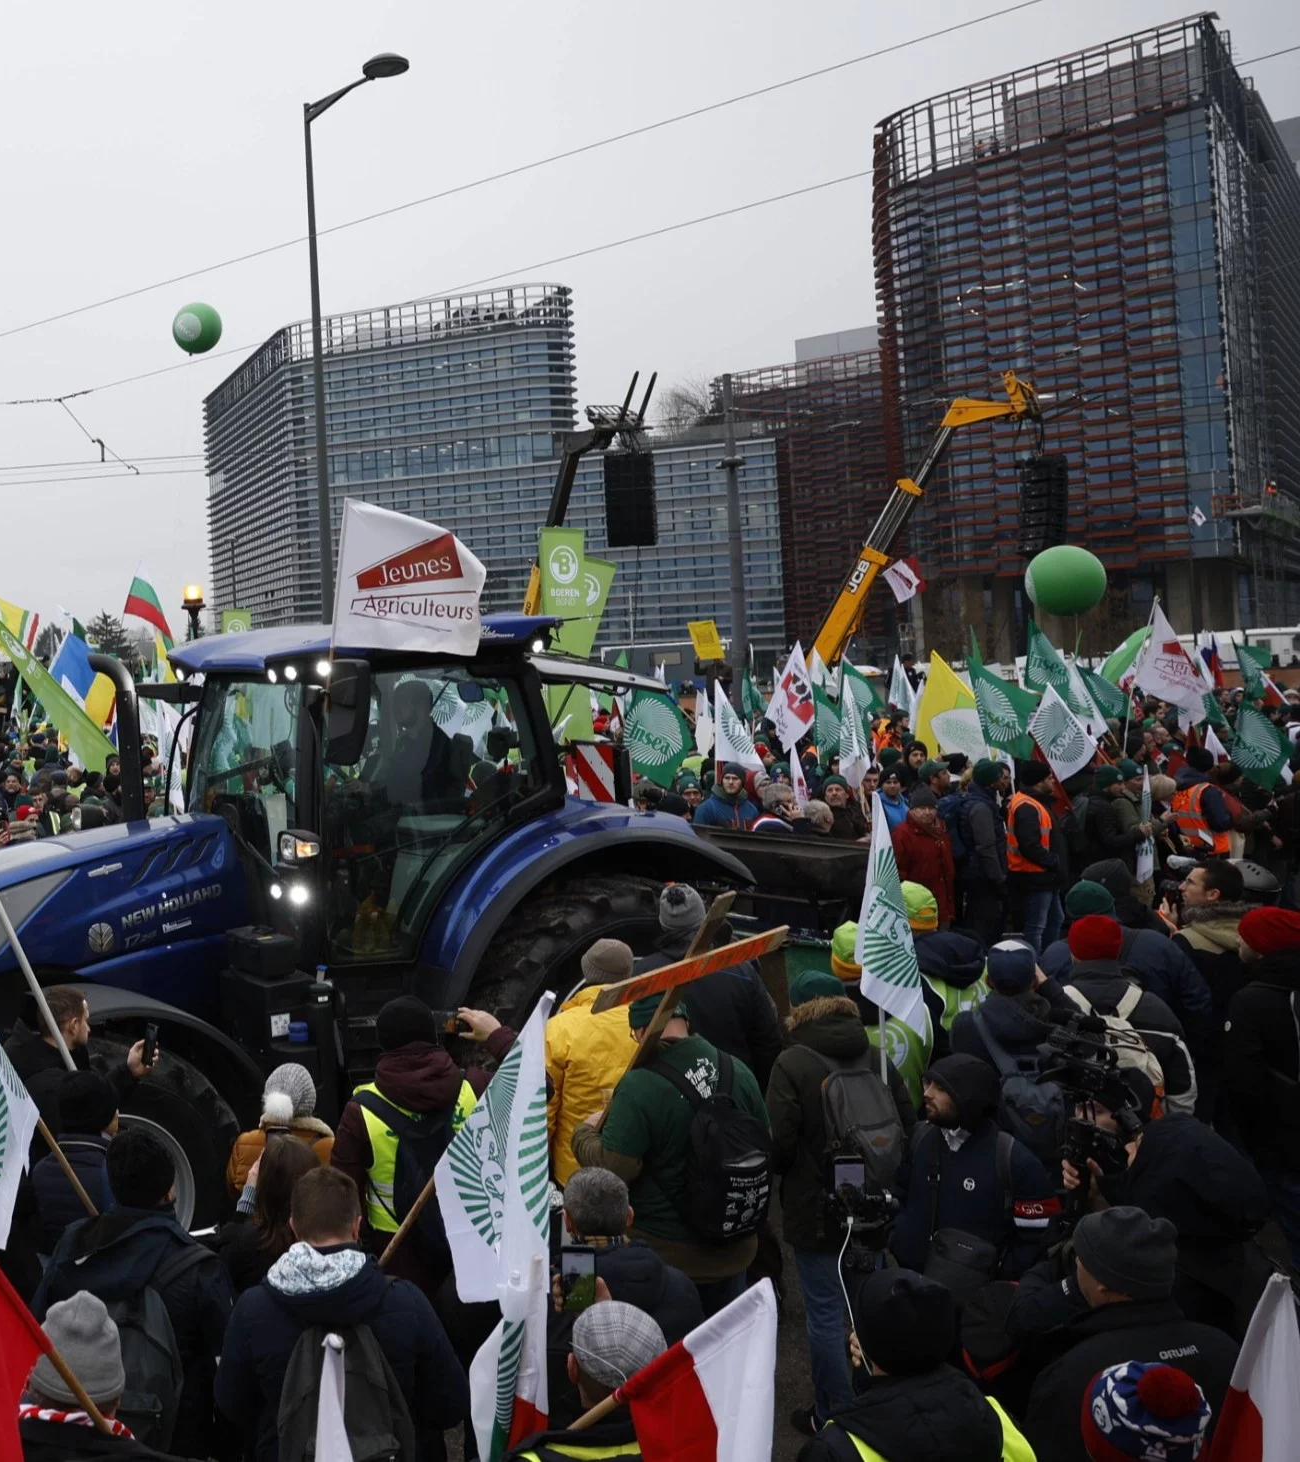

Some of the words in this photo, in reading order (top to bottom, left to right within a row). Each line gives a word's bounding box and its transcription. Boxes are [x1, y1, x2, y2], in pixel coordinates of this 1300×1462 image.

[378, 555, 452, 586] Jeunes
[847, 560, 871, 594] JCB
[363, 594, 474, 621] Agriculteurs
[550, 587, 580, 598] BOEREN
[121, 905, 156, 930] NEW
[158, 883, 223, 917] HOLLAND
